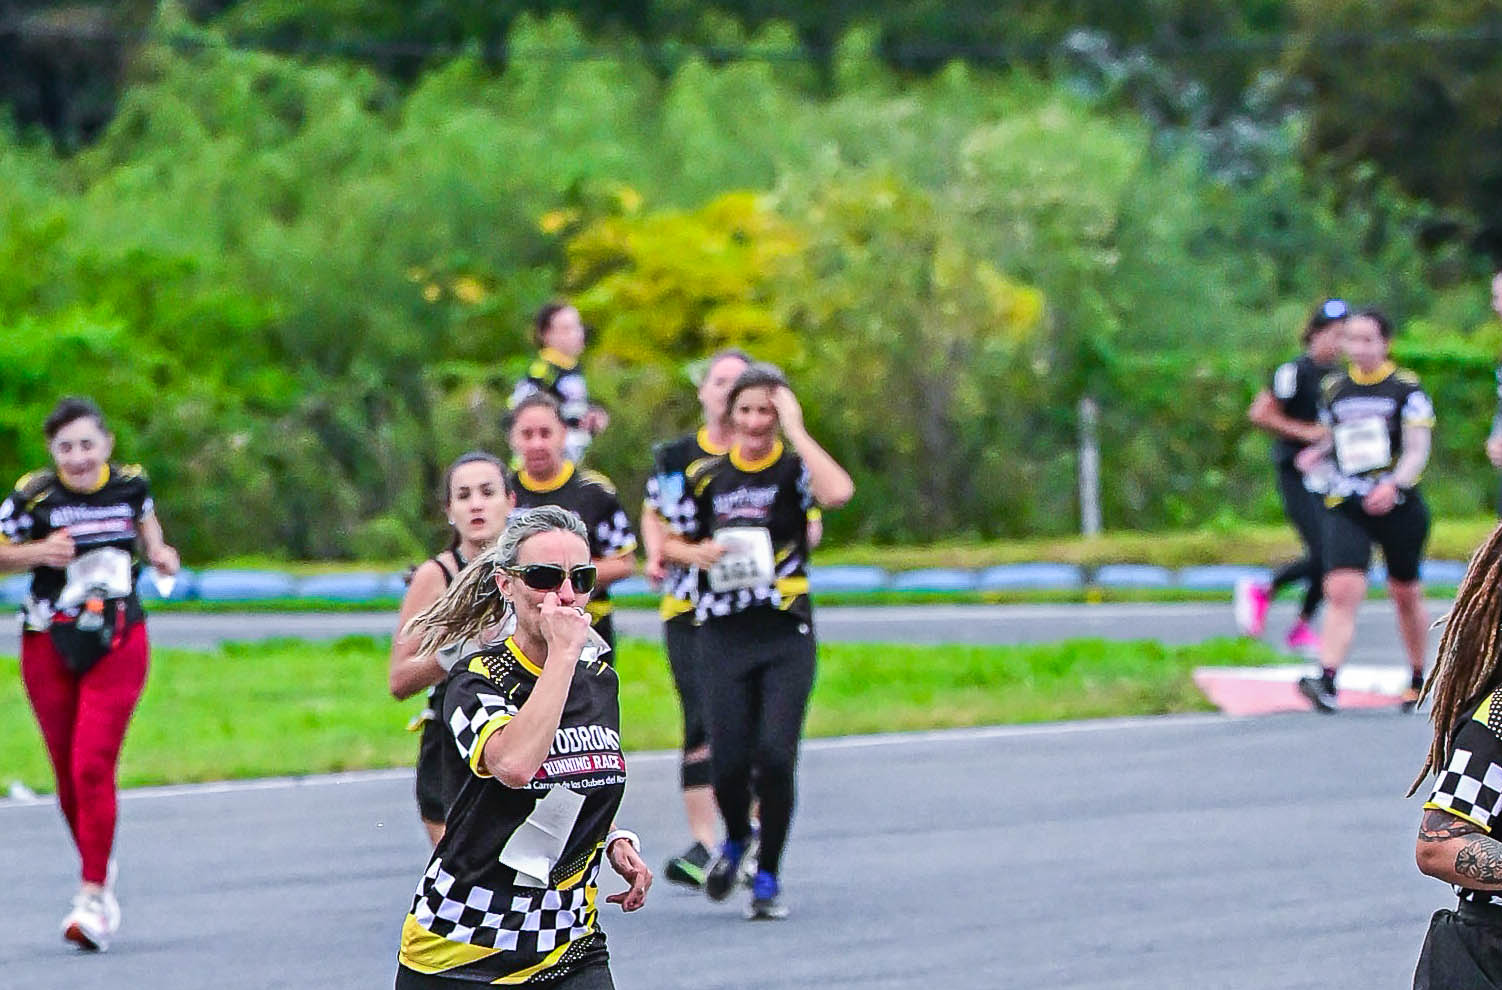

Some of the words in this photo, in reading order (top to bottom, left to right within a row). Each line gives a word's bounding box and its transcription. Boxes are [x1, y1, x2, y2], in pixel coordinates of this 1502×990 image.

[542, 755, 592, 776] RUNNING
[592, 754, 621, 770] RACE
[606, 775, 616, 785] del
